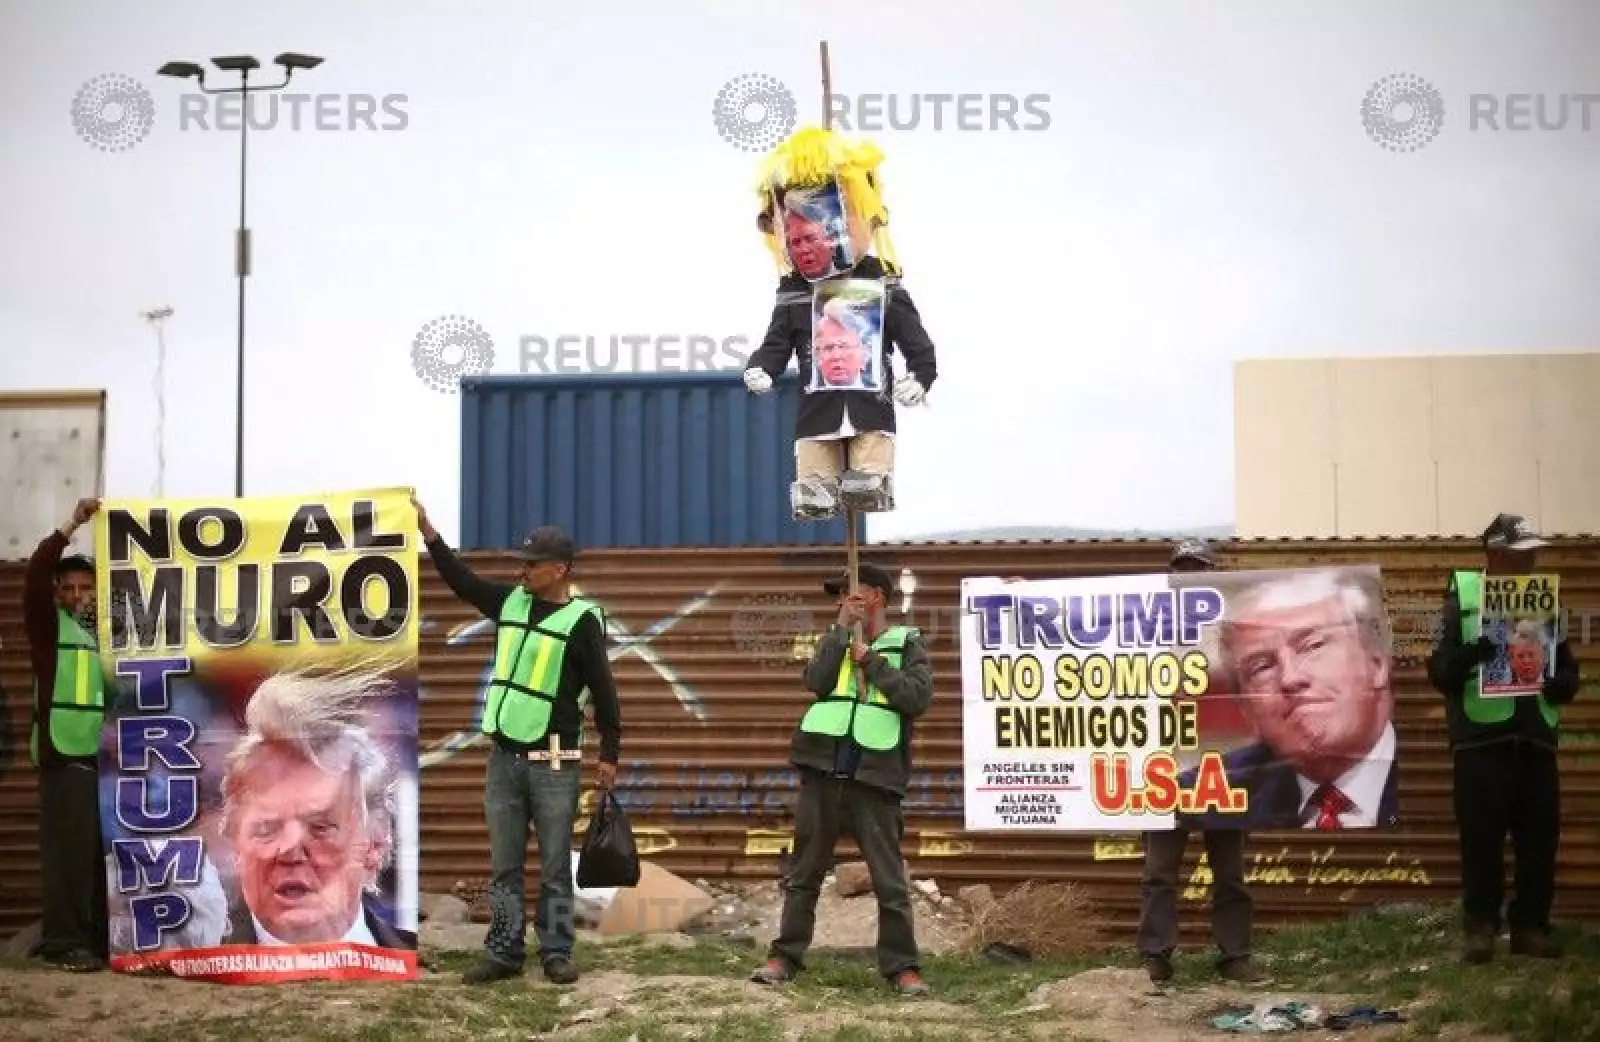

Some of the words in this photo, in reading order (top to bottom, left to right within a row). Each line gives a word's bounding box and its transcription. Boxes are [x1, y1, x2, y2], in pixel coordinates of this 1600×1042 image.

[108, 503, 247, 562] NO
[278, 499, 406, 557] AL
[110, 554, 411, 649] MURO
[1485, 579, 1517, 593] NO
[1527, 577, 1551, 592] AL
[1485, 592, 1555, 612] MURO
[967, 587, 1225, 651] TRUMP
[982, 653, 1043, 701] NO
[1054, 651, 1209, 701] SOMOS
[995, 704, 1149, 748] ENEMIGOS
[1159, 702, 1199, 750] DE
[983, 762, 1046, 773] ANGELES
[1051, 762, 1075, 773] SIN
[987, 775, 1068, 784] FRONTERAS
[1090, 751, 1248, 815] U.S.A.
[112, 657, 202, 951] TRUMP
[995, 805, 1062, 814] MIGRANTE
[1001, 794, 1056, 803] ALIANZA
[1001, 815, 1056, 824] TIJUANA
